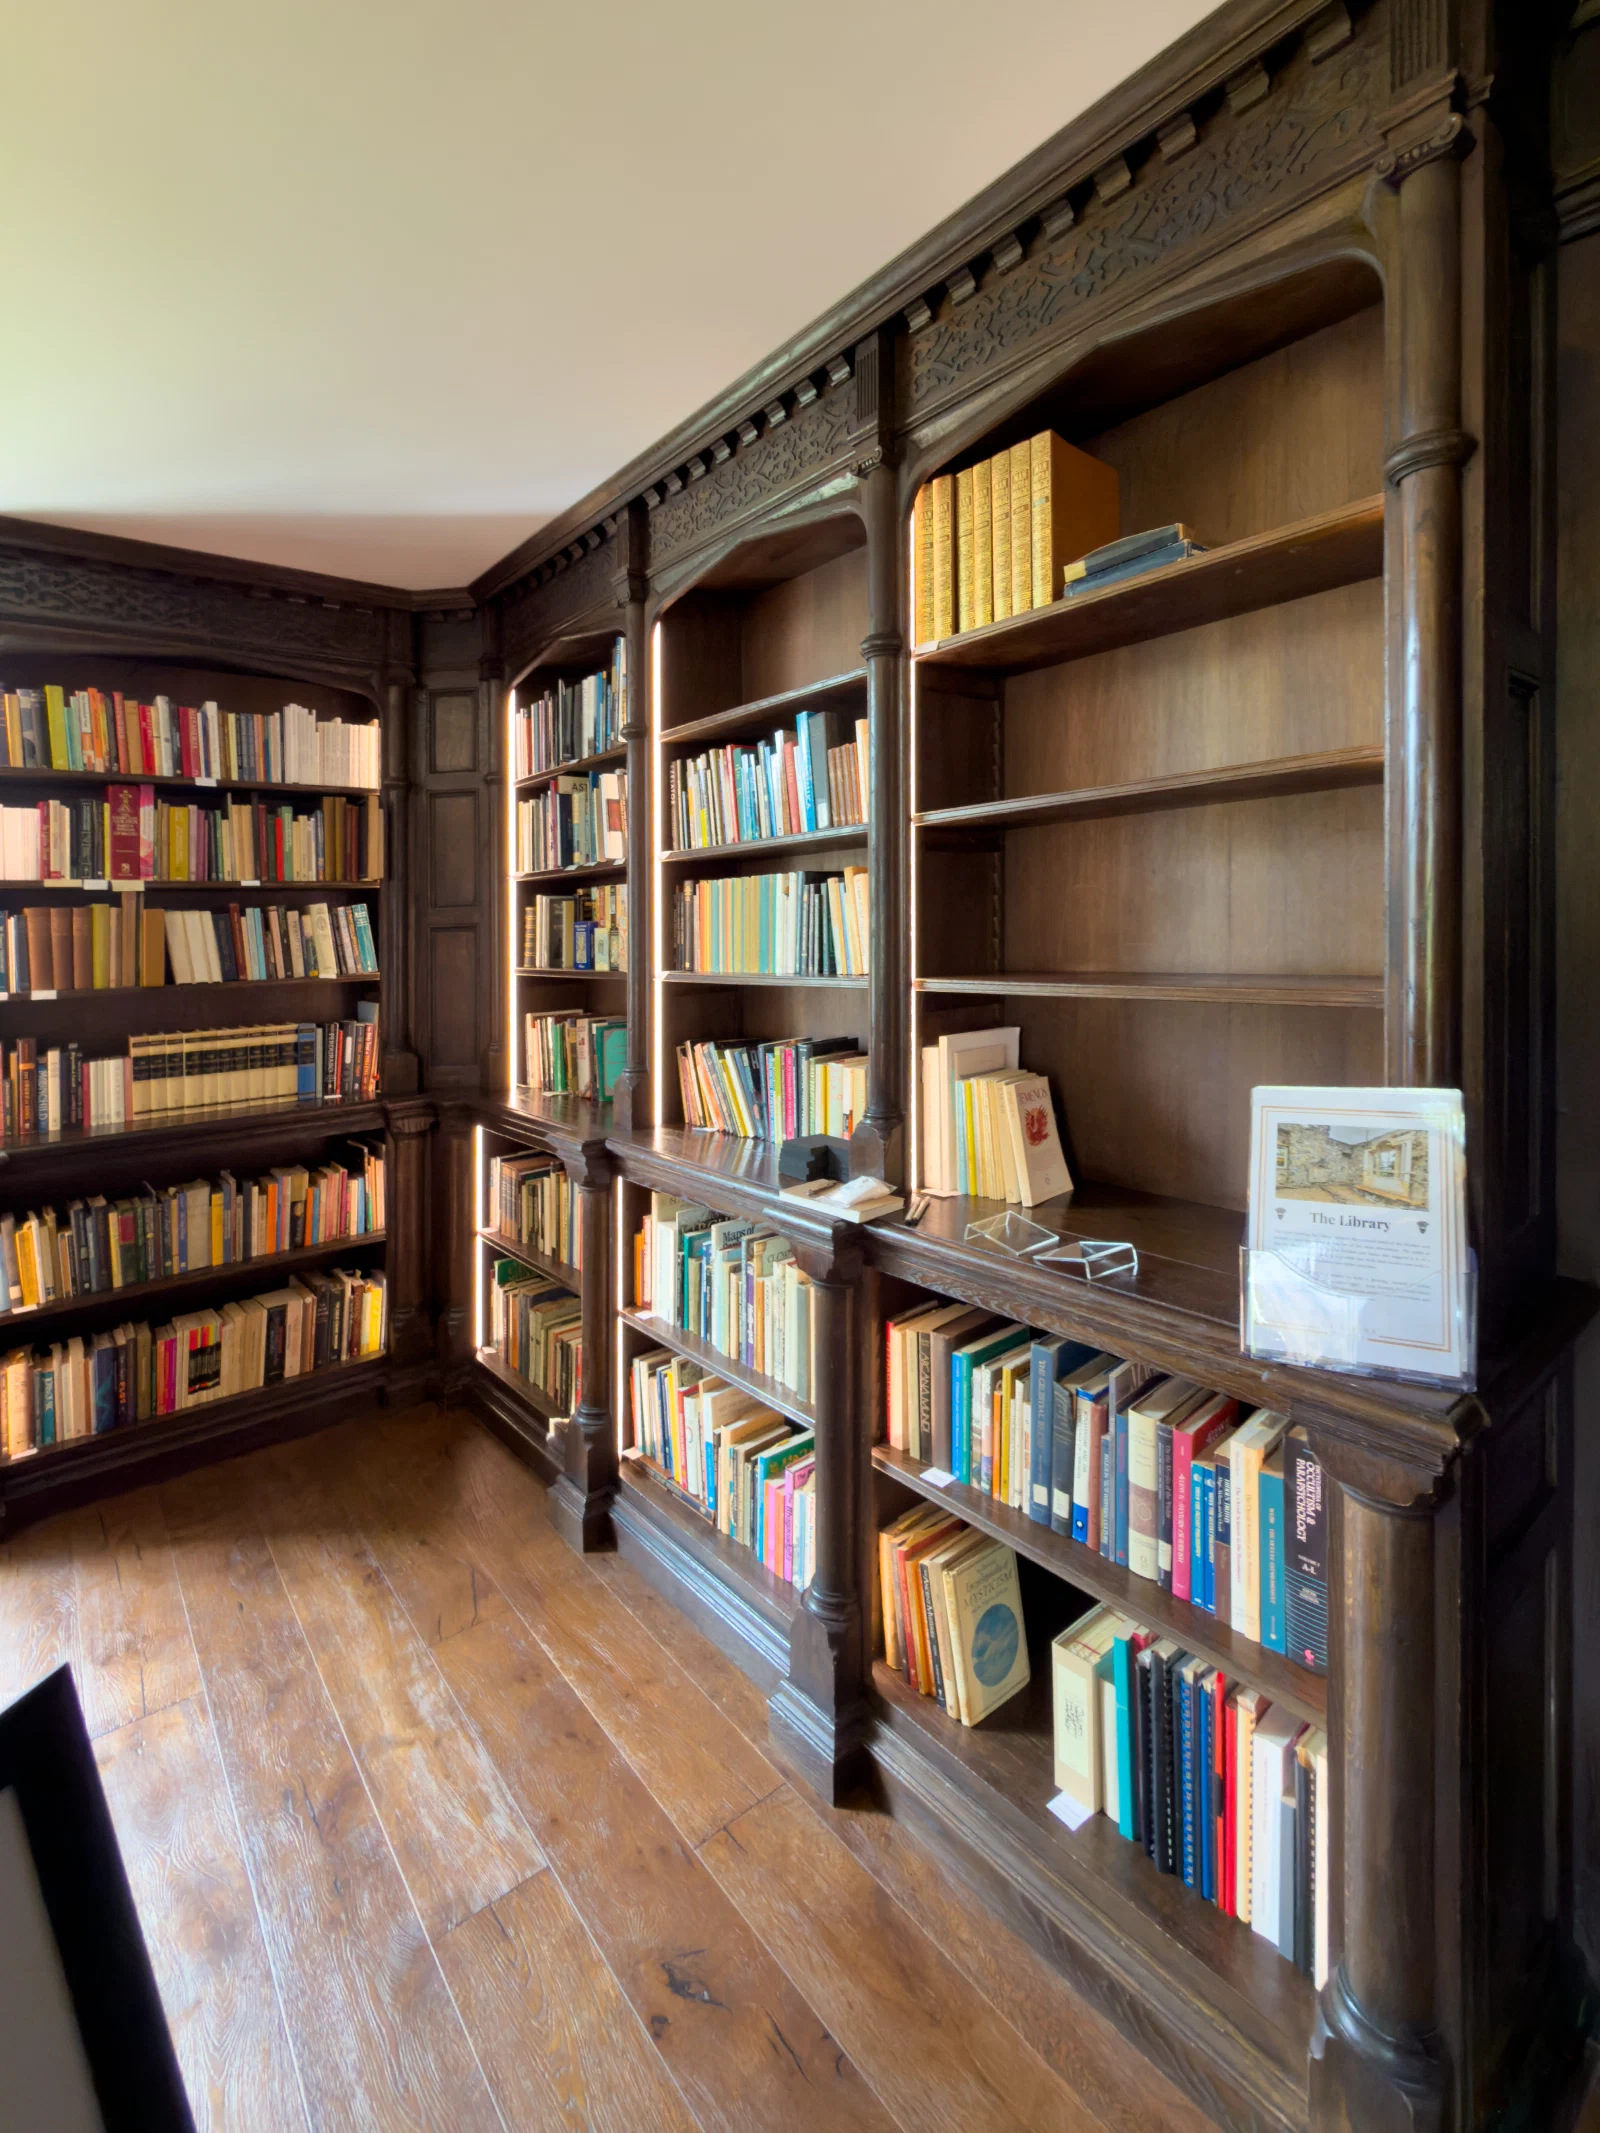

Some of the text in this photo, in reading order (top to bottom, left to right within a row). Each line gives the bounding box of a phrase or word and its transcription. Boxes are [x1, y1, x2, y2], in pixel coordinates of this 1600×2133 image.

[1310, 1212, 1391, 1233] The Library
[722, 1229, 747, 1244] Maps
